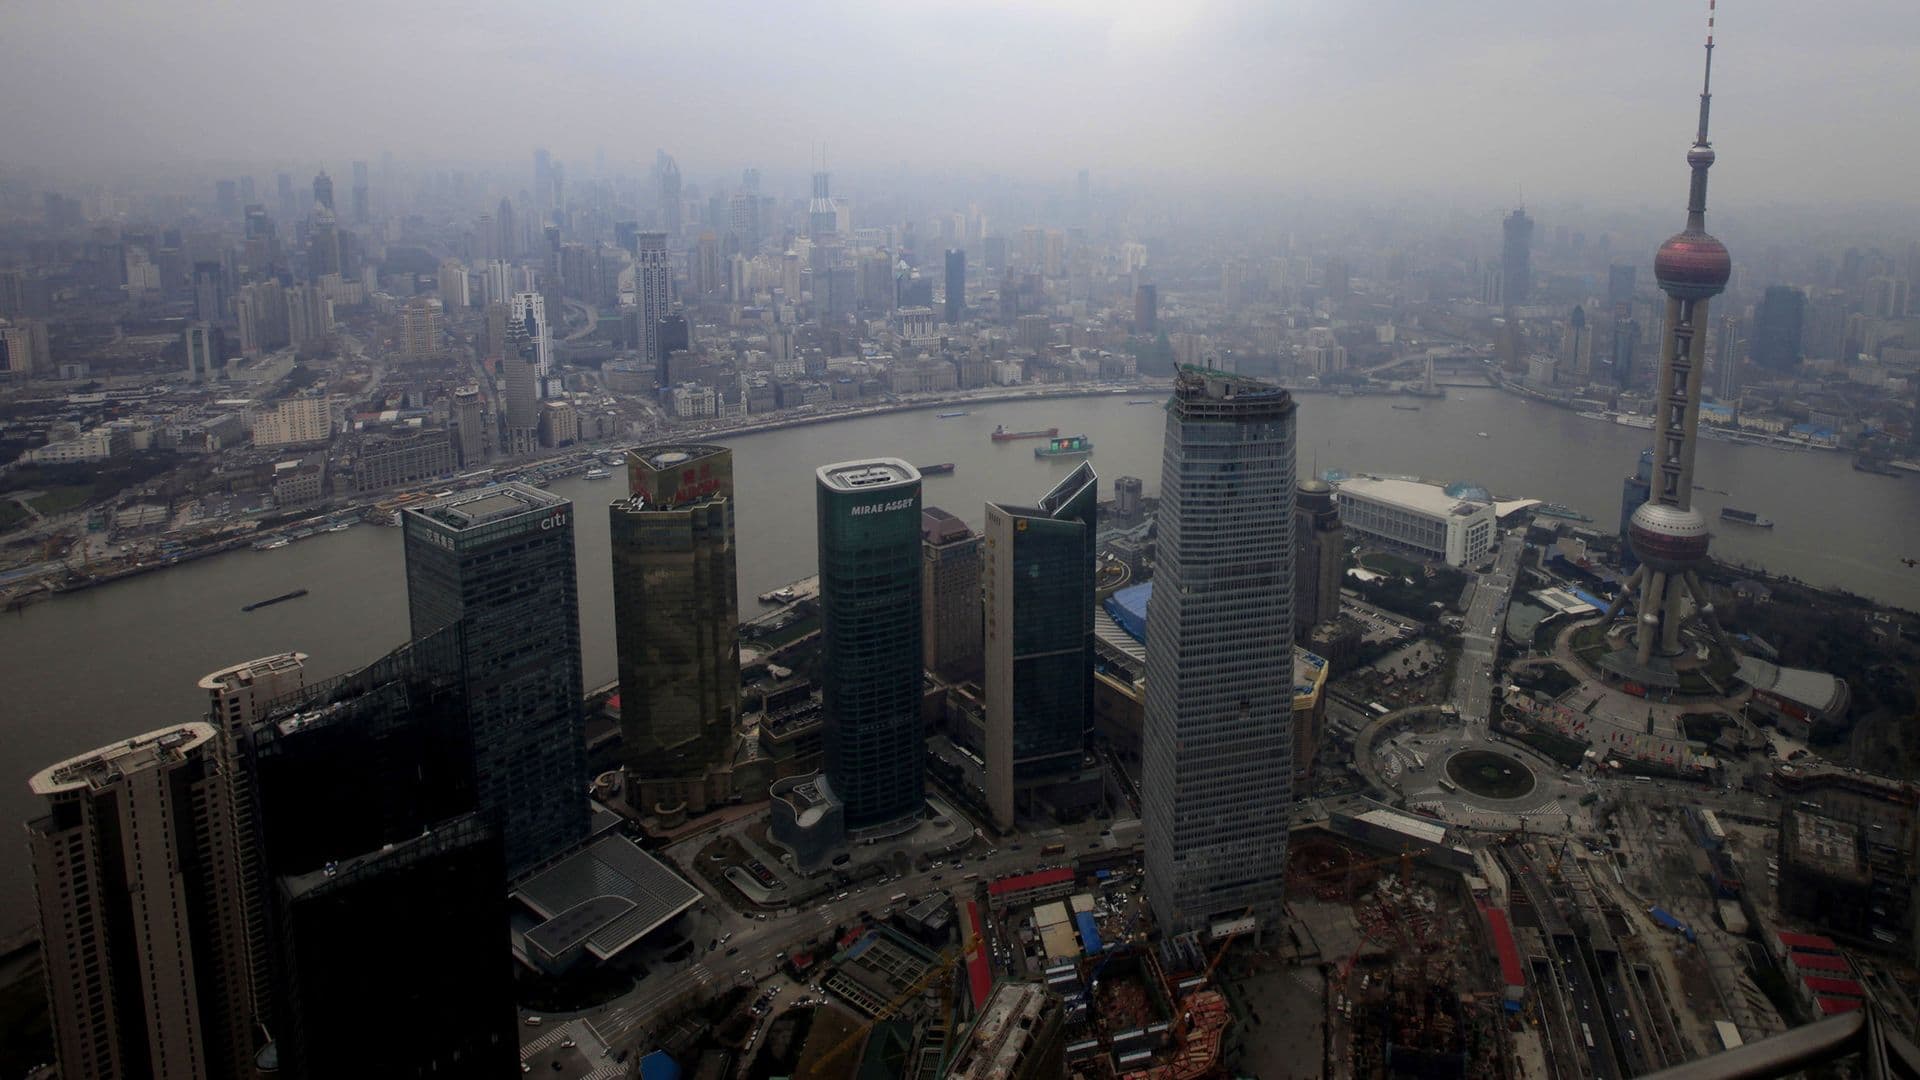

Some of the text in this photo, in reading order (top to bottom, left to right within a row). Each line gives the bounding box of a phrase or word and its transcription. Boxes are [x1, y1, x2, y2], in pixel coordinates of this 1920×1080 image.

[851, 498, 914, 516] MIRAE ASSET
[541, 513, 566, 531] citi
